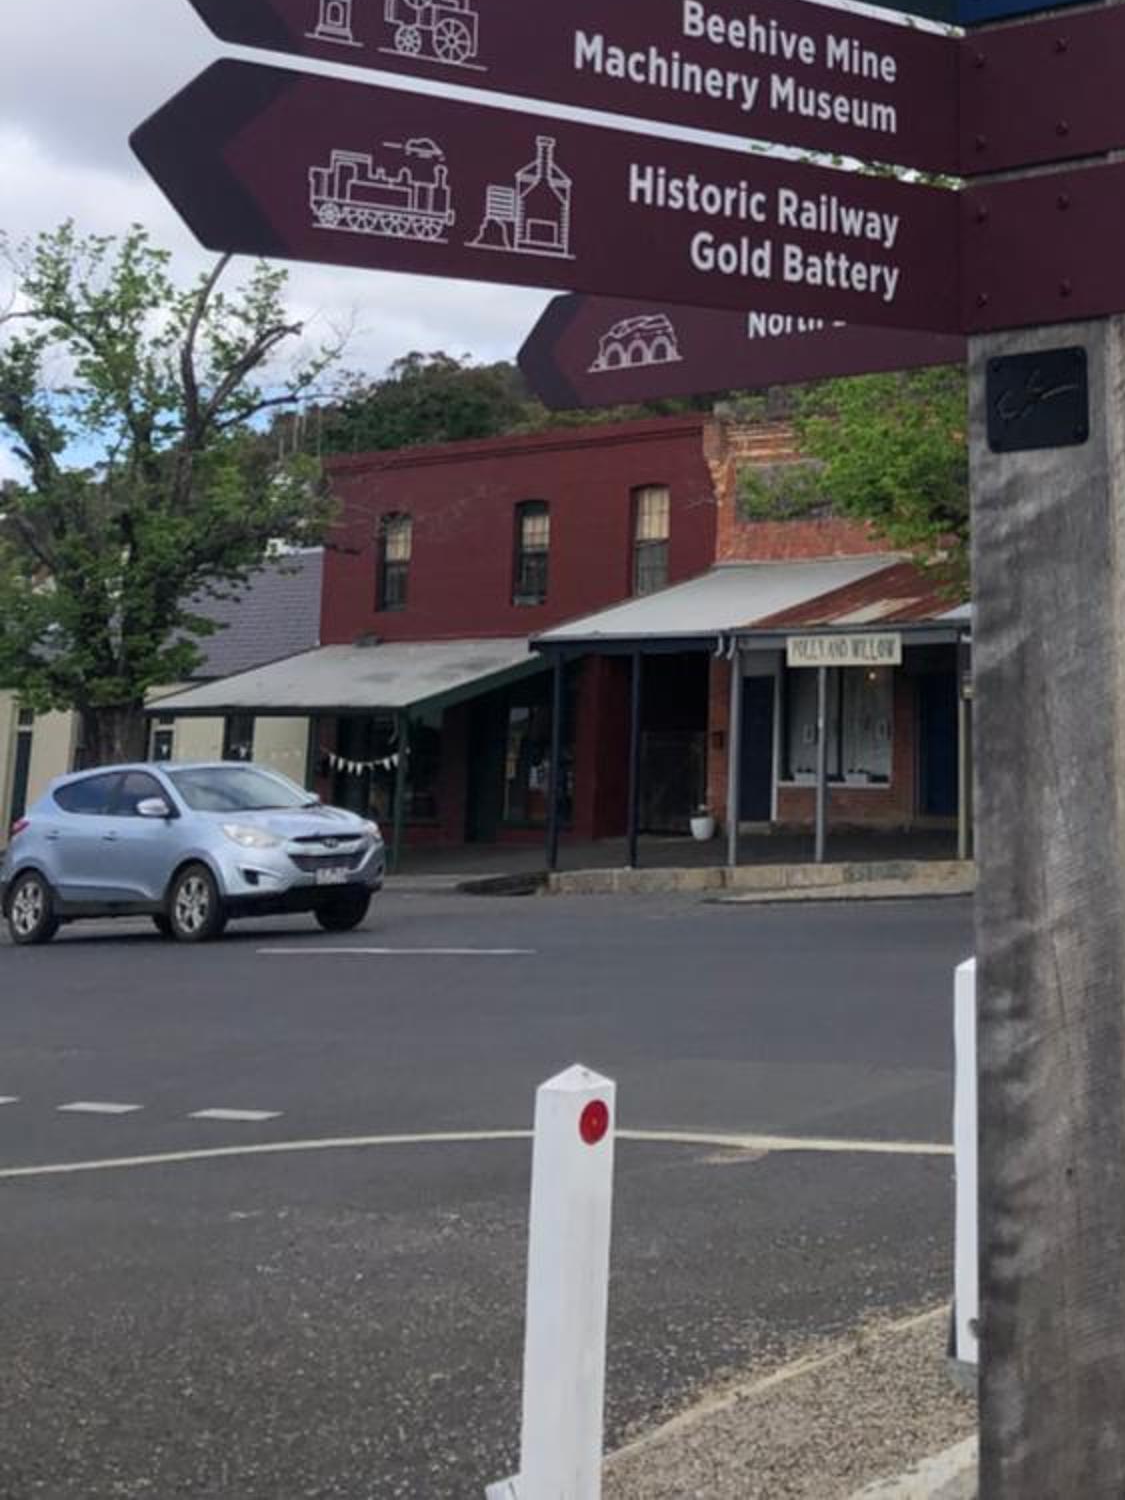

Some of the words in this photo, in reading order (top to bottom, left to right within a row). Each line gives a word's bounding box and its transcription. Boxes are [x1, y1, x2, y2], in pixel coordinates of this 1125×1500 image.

[574, 30, 759, 111] Machinery
[770, 73, 897, 133] Museum
[826, 34, 897, 83] Mine
[629, 163, 766, 222] Historic
[778, 188, 899, 249] Railway
[690, 231, 772, 279] Gold
[783, 243, 899, 302] Battery
